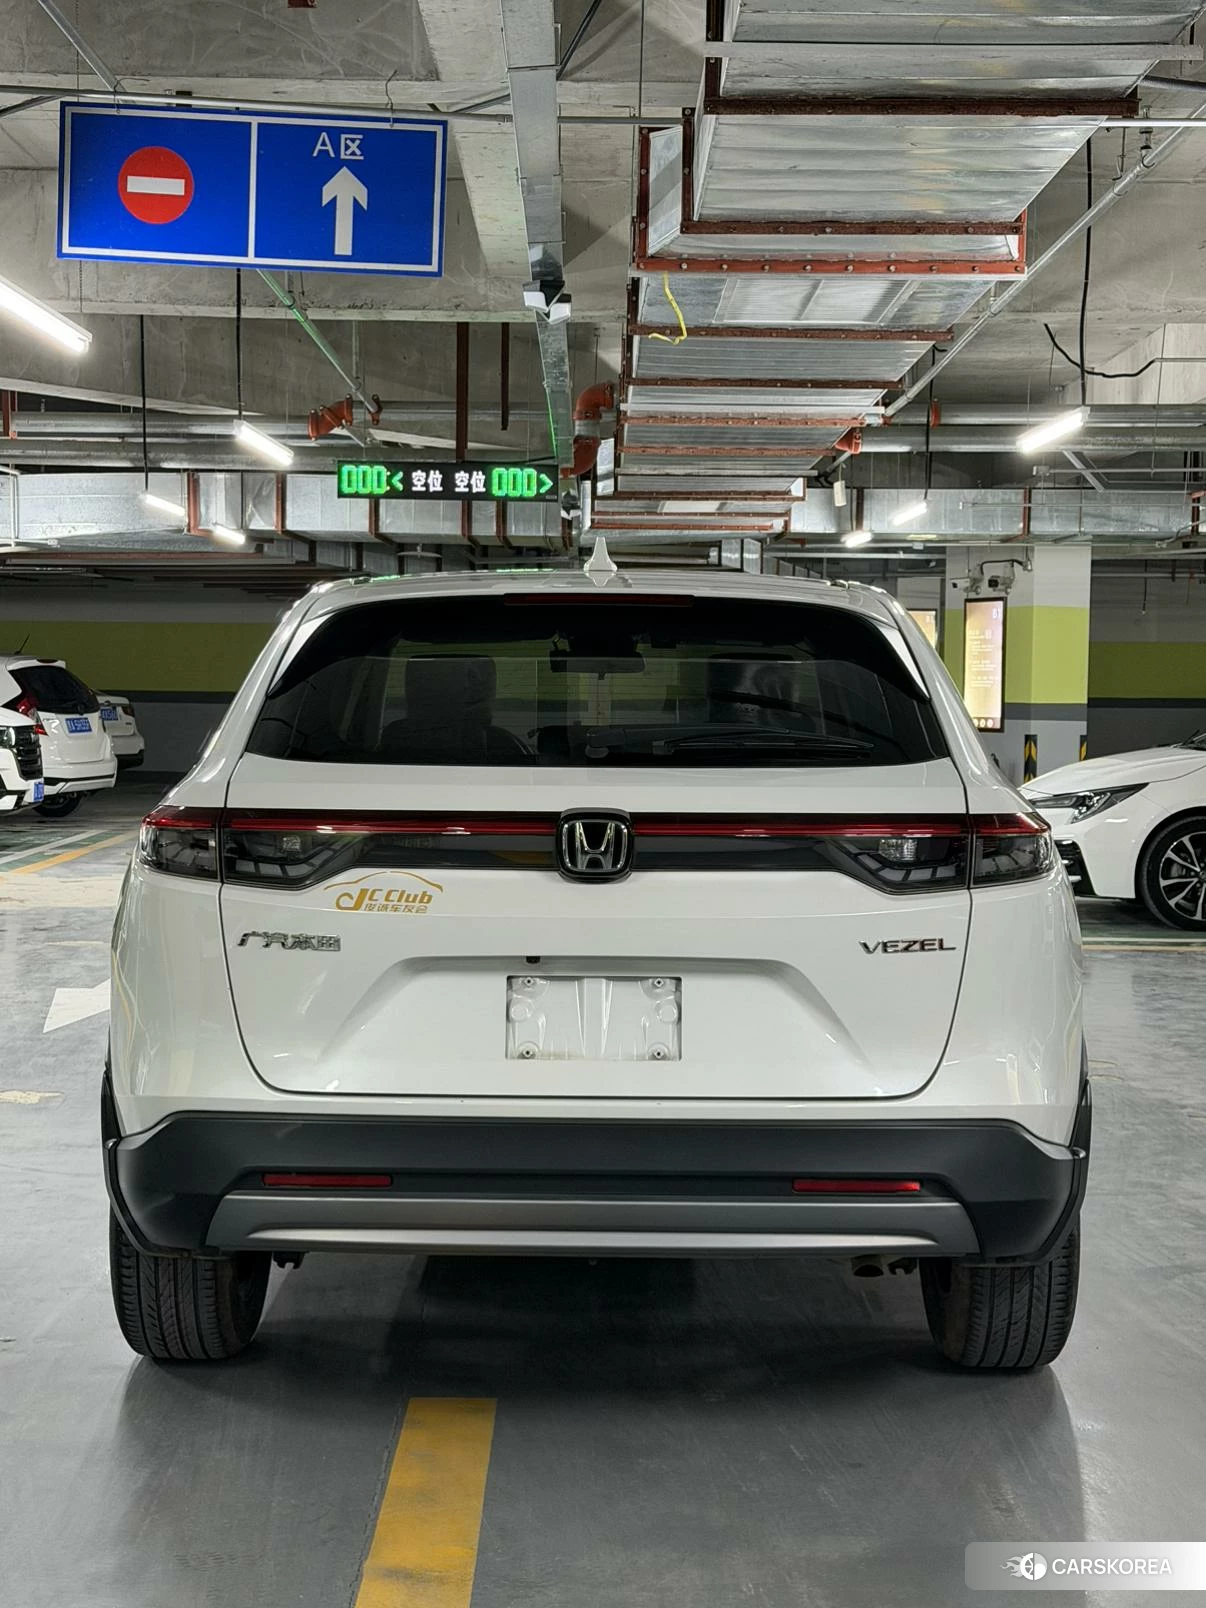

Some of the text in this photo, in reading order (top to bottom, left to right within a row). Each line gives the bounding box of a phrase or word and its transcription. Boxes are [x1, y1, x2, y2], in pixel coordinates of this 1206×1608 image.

[411, 469, 443, 492] 空位
[454, 470, 486, 493] 空位
[384, 889, 433, 905] Club
[858, 937, 957, 955] VEZEL
